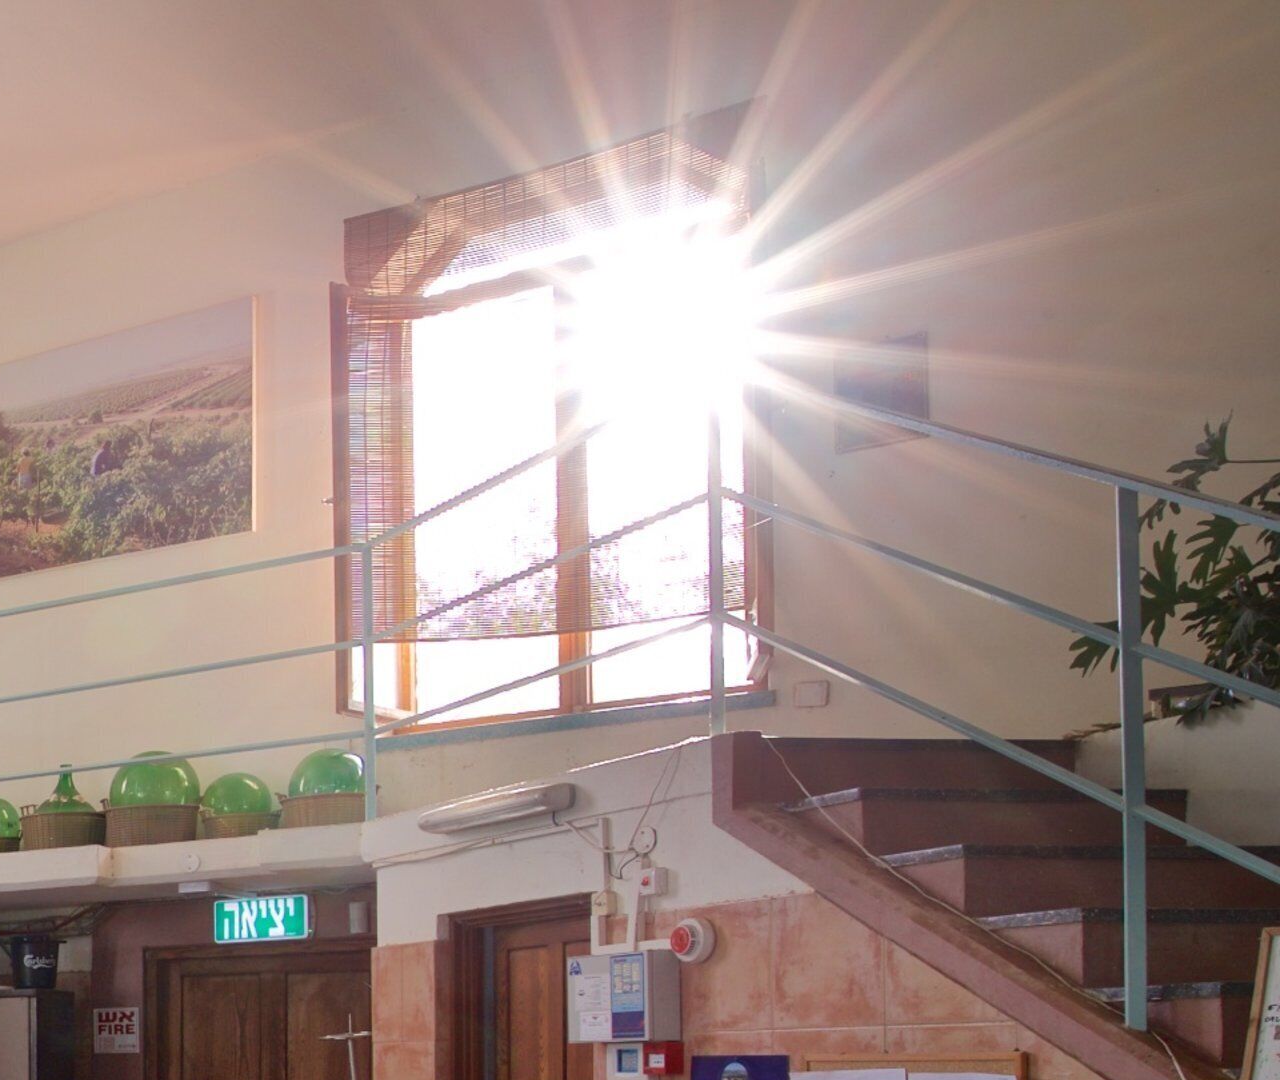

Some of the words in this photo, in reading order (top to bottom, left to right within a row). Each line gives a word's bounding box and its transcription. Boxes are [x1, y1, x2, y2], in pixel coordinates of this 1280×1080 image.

[224, 897, 295, 940] יציאה
[97, 1011, 135, 1023] אש
[97, 1023, 136, 1036] FIRE
